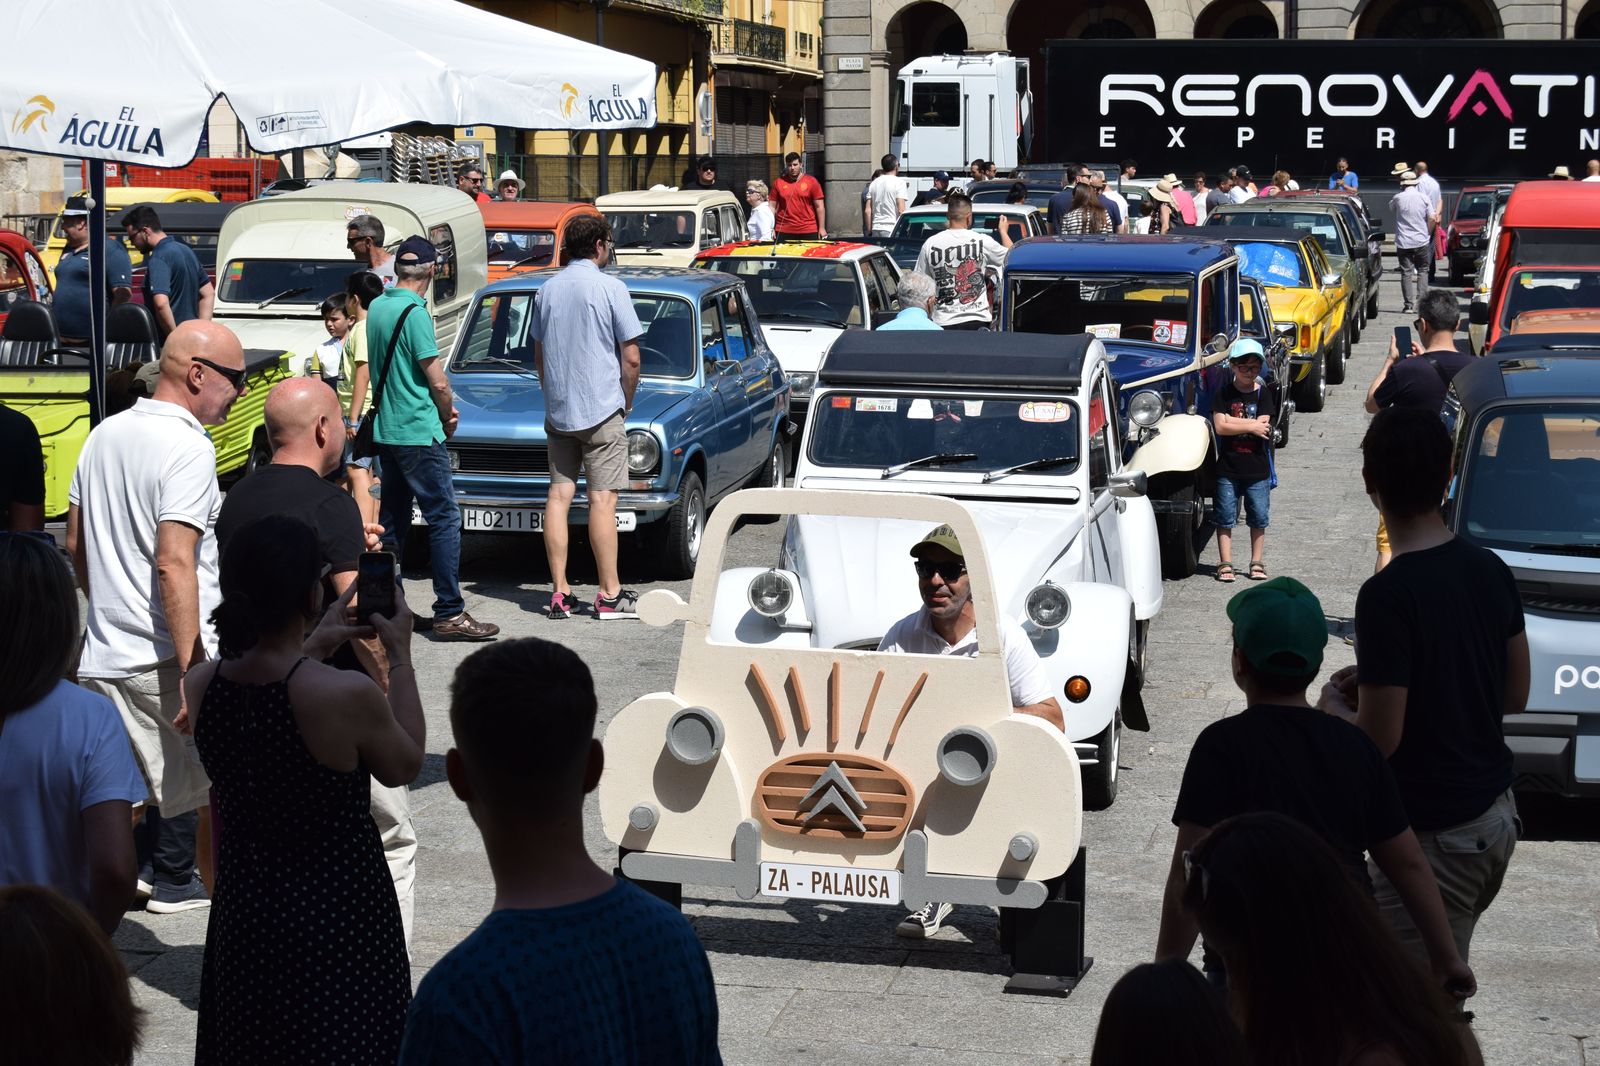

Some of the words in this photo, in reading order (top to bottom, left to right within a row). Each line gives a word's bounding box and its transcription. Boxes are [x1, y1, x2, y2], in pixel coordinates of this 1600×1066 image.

[612, 84, 622, 97] EL
[1099, 68, 1596, 122] RENOVATI
[119, 106, 135, 122] EL
[588, 95, 648, 122] ÁGUILA
[58, 113, 165, 157] ÁGUILA
[930, 238, 984, 266] devil
[768, 868, 790, 892] ZA
[811, 871, 890, 899] PALAUSA
